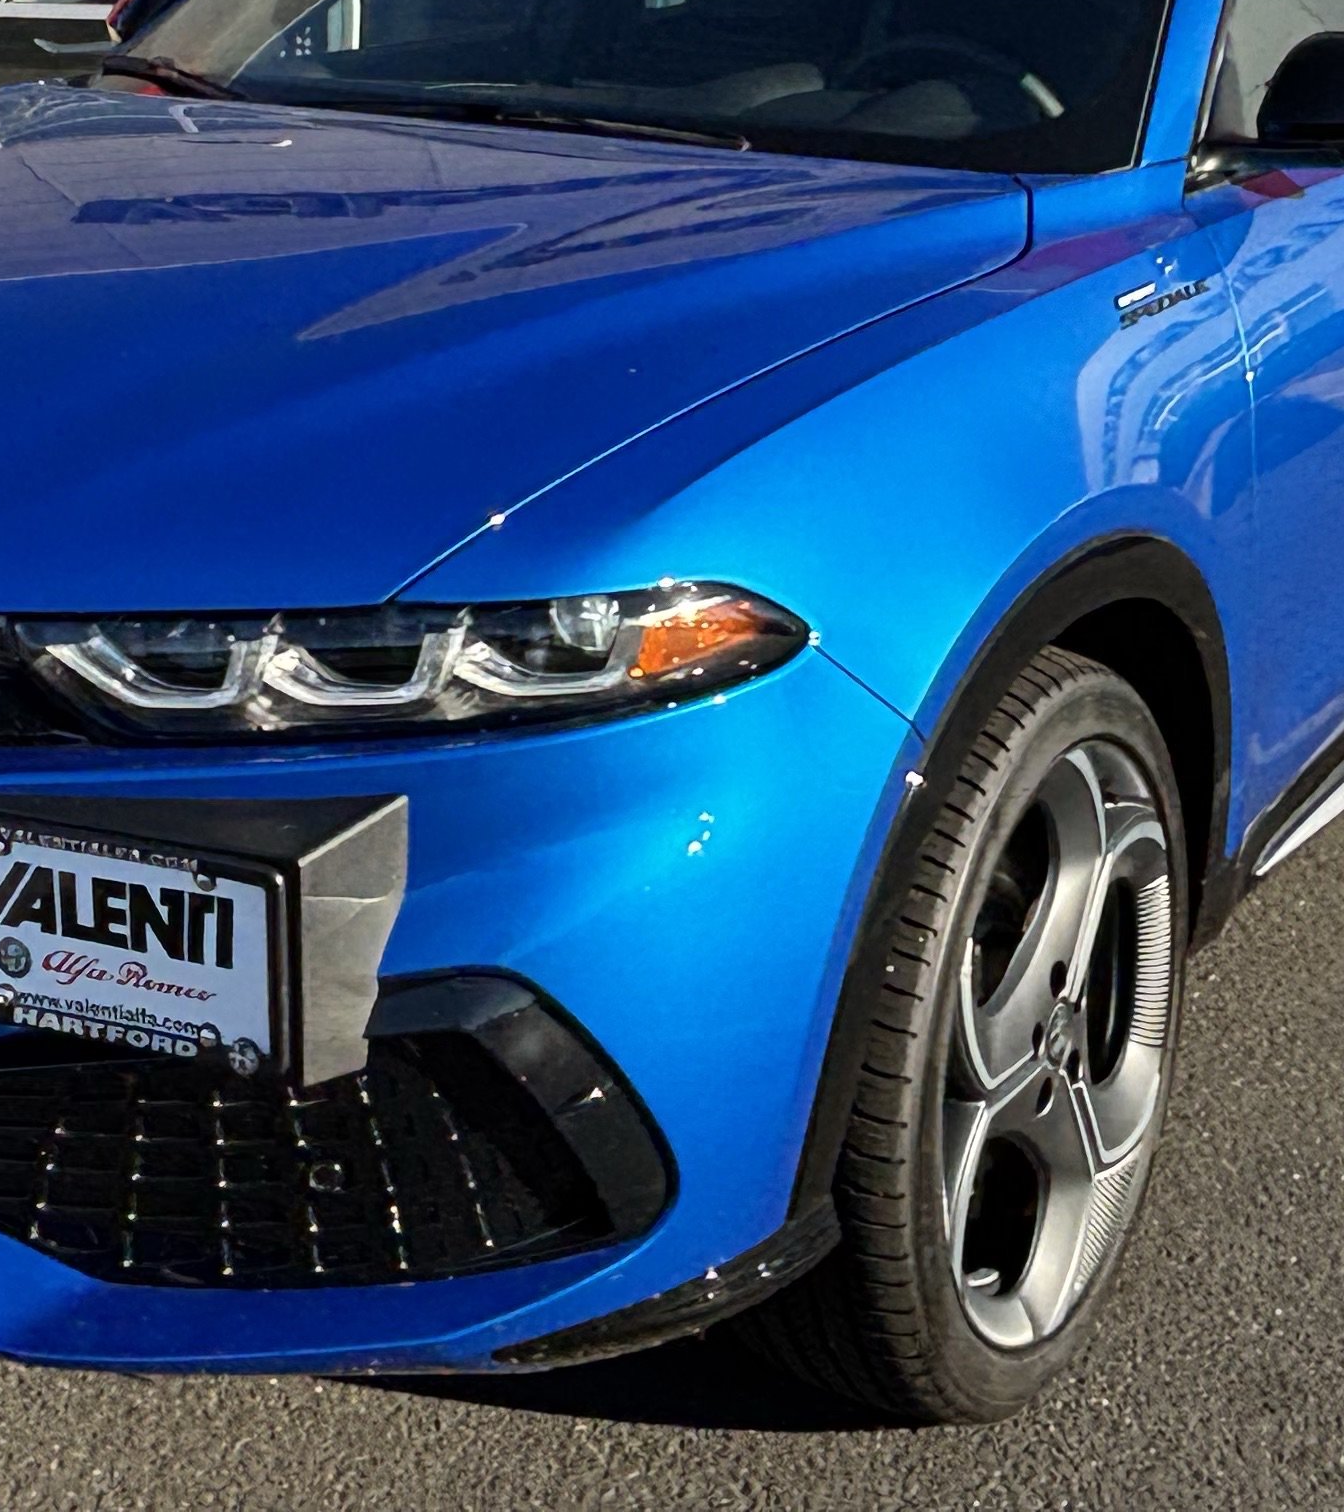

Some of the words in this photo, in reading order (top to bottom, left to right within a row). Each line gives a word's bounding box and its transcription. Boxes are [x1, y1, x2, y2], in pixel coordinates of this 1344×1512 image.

[42, 950, 114, 985] Alfa
[116, 961, 217, 1001] Romeo
[13, 1006, 198, 1057] HARTFORD
